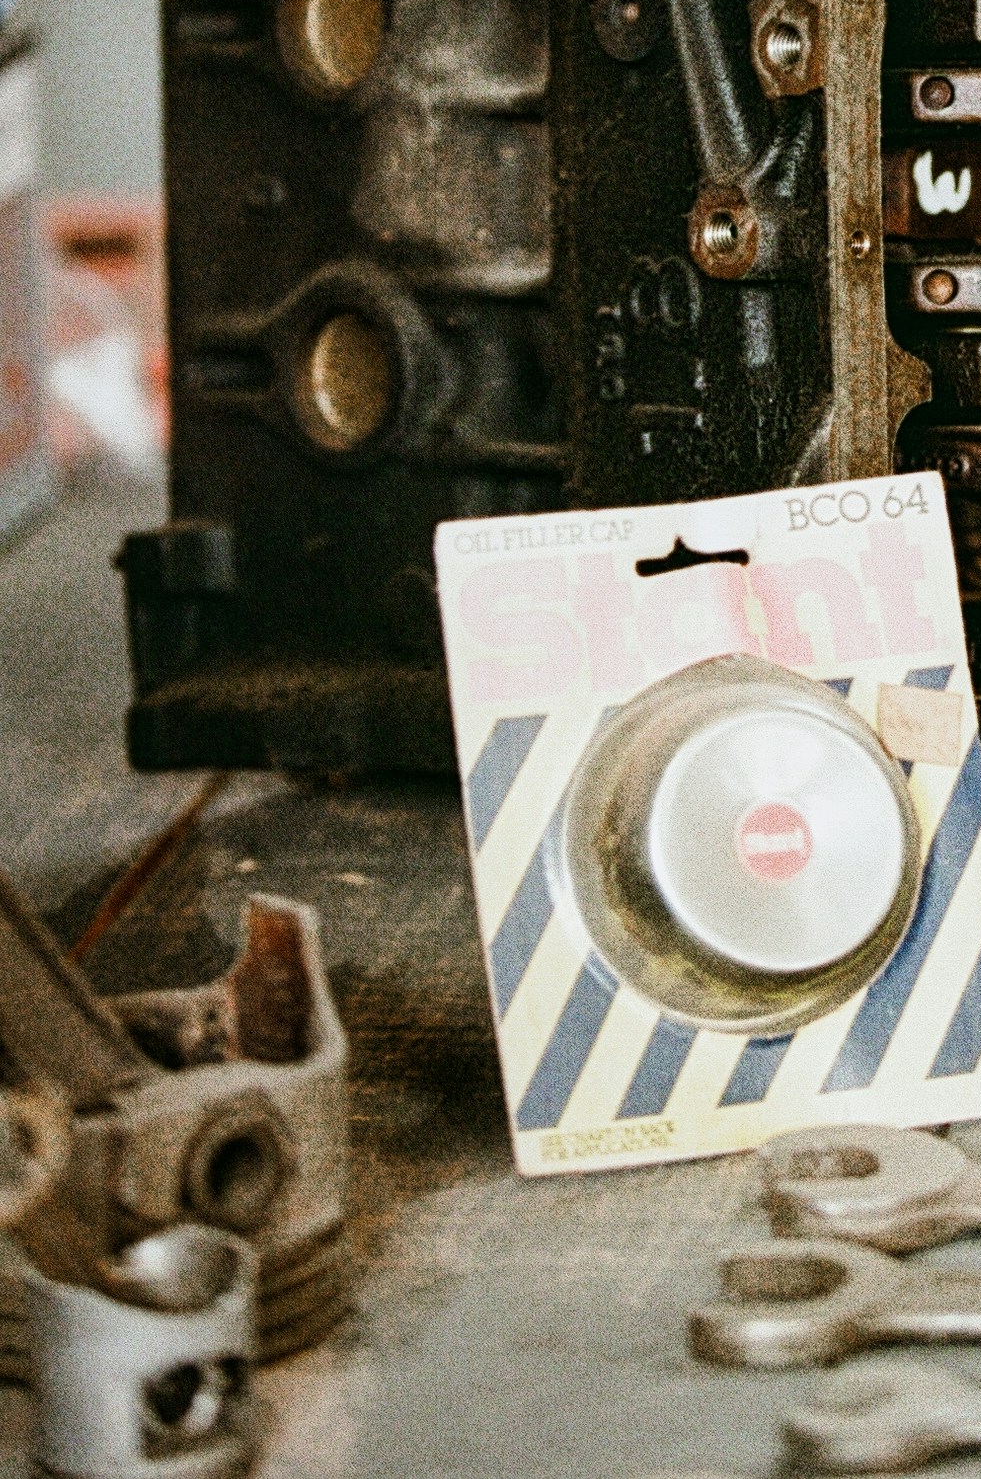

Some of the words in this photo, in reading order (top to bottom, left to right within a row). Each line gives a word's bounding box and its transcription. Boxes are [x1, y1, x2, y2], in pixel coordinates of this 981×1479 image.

[785, 490, 871, 531] BCO
[882, 482, 929, 519] 64
[454, 530, 498, 554] OIL
[501, 523, 584, 550] FILLER
[589, 519, 634, 543] CAP
[458, 521, 939, 703] Stant
